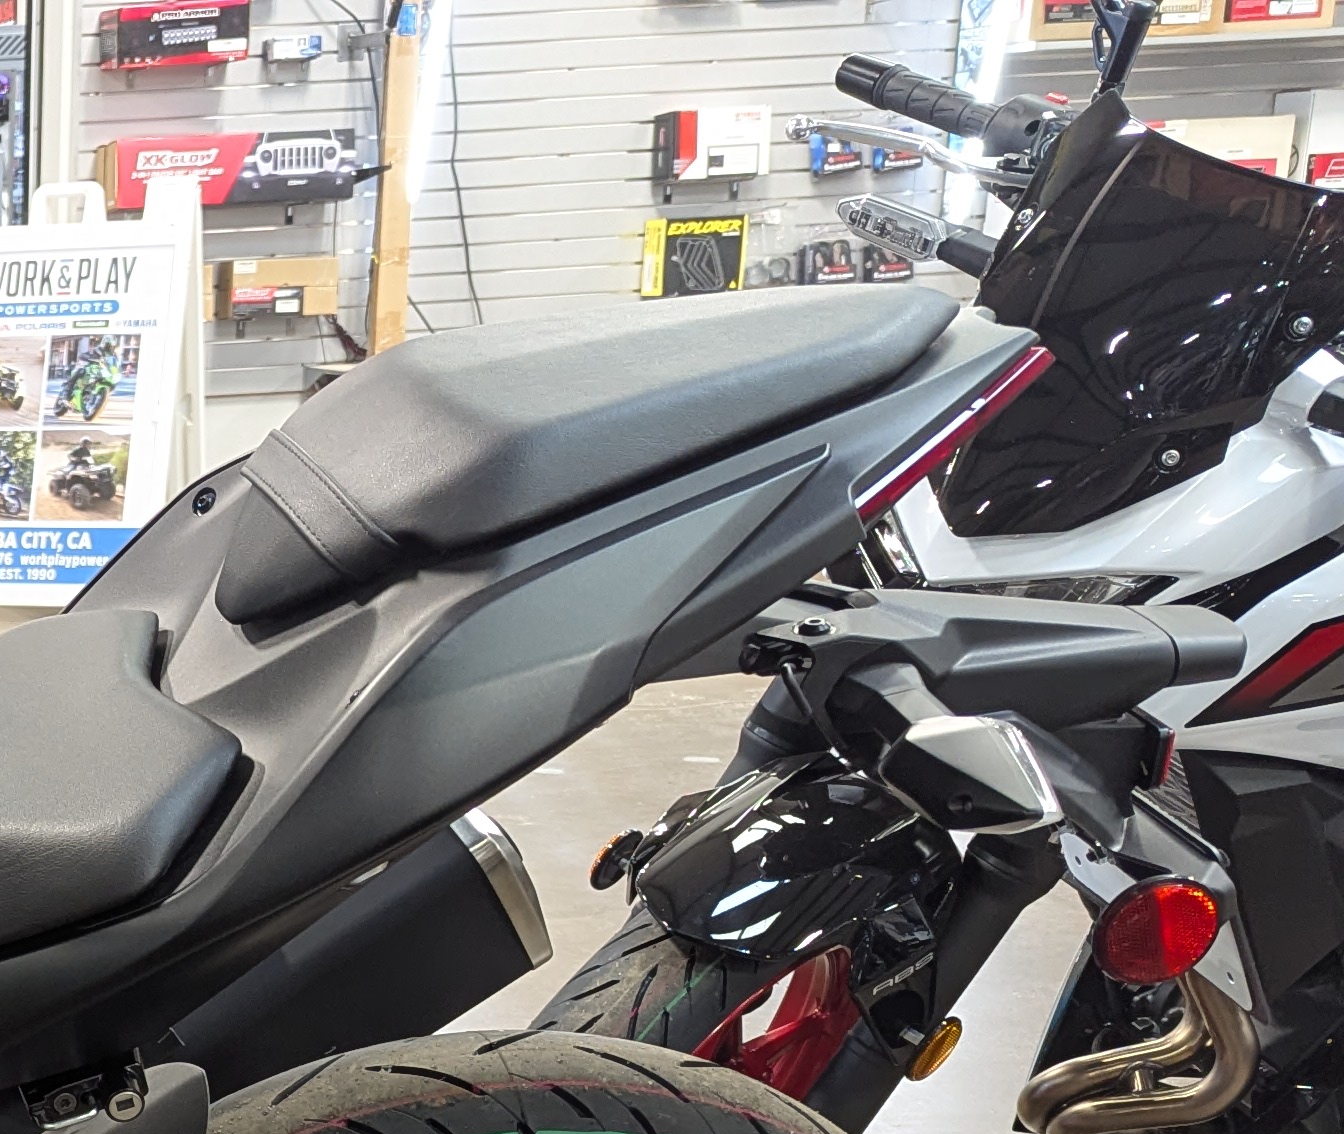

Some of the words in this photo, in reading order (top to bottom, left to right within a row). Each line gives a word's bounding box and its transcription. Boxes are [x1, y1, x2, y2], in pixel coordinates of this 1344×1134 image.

[667, 219, 742, 235] EXPLORER
[21, 531, 64, 552] CITY,
[66, 531, 92, 549] CA
[26, 568, 56, 581] 1990
[873, 951, 934, 996] ABS
